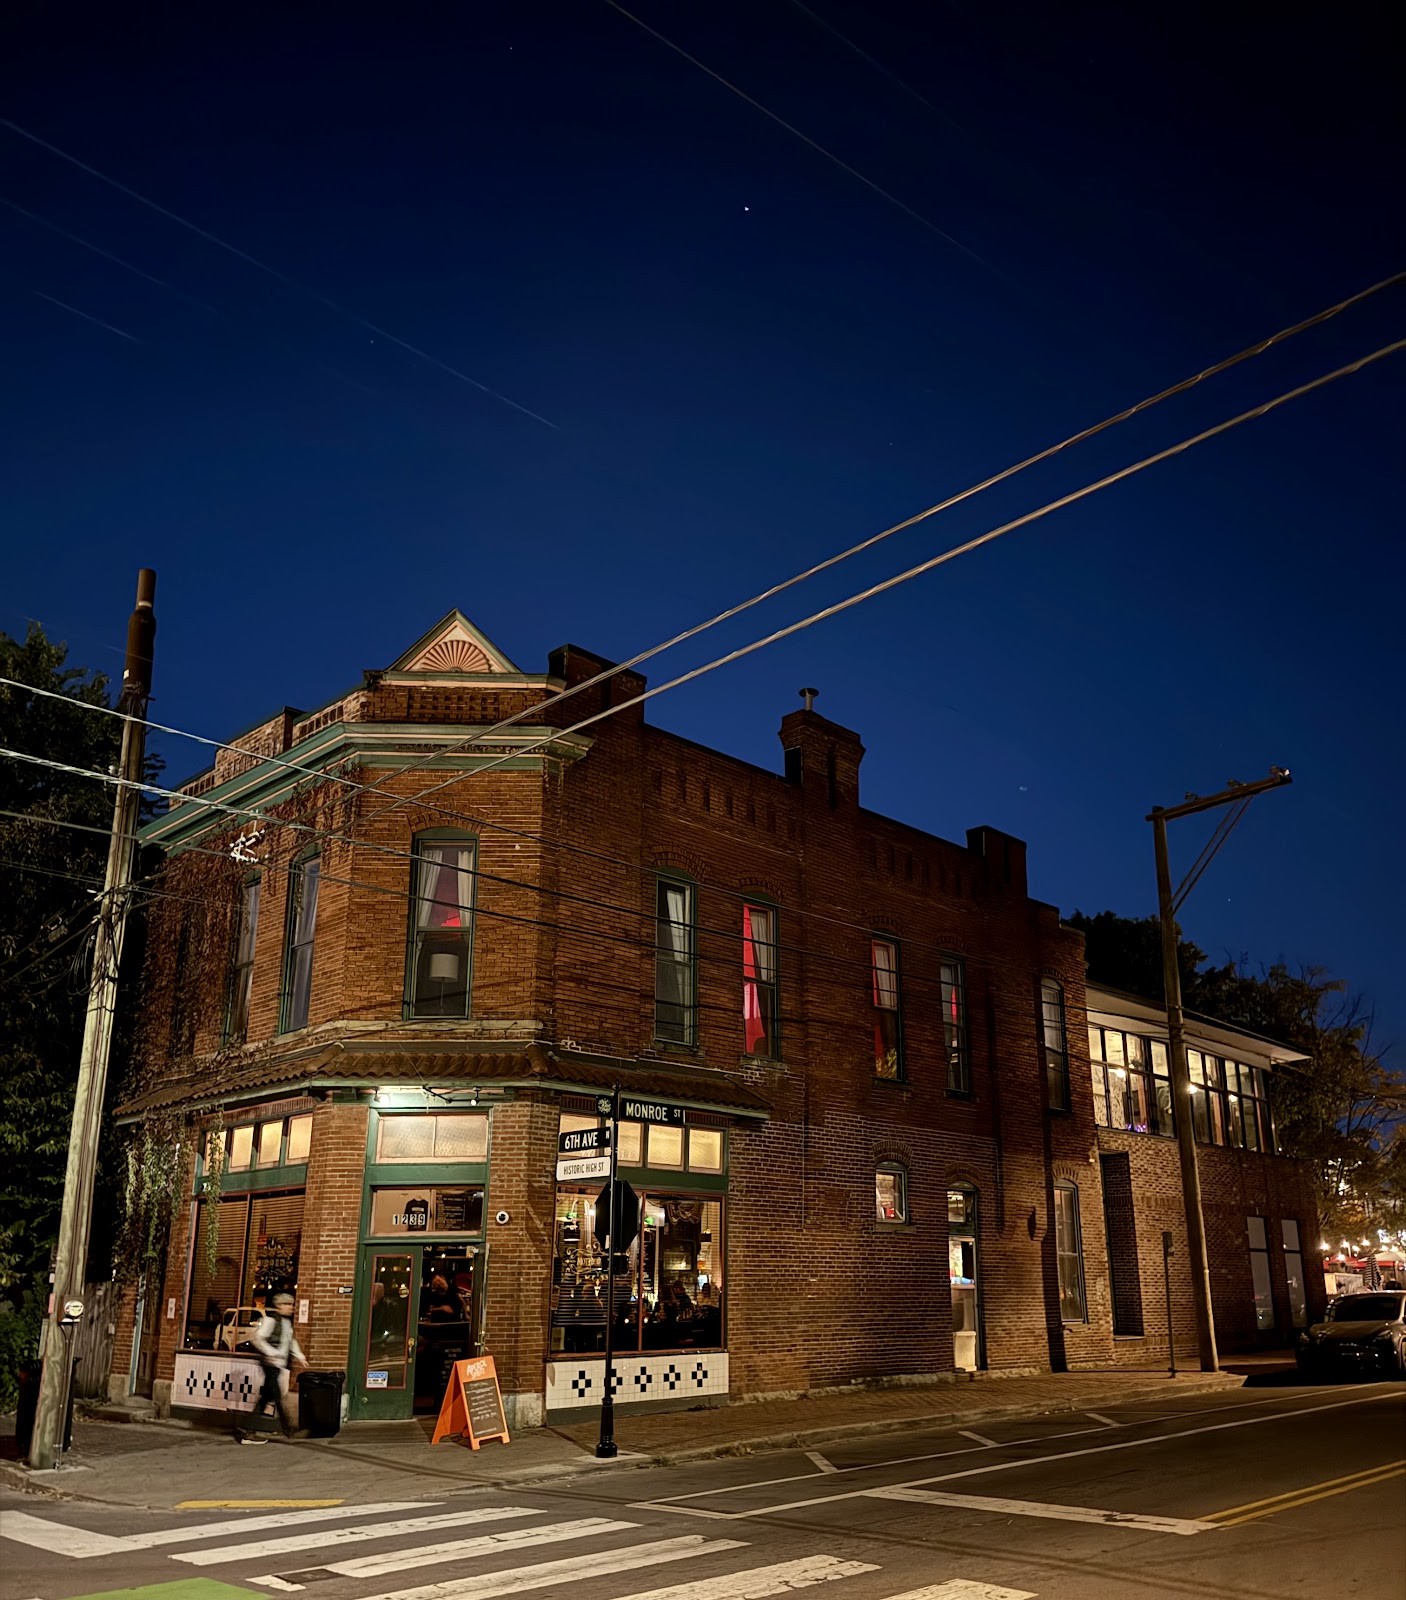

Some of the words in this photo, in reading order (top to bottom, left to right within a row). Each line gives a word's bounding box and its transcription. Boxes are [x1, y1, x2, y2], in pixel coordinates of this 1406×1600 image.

[626, 1101, 668, 1121] MONROE
[674, 1109, 681, 1118] ST
[565, 1134, 580, 1149] 6TH
[581, 1131, 598, 1148] AVE
[563, 1164, 585, 1175] HISTORIC
[586, 1162, 597, 1172] HIGH
[598, 1161, 604, 1172] ST
[394, 1214, 424, 1225] 1239
